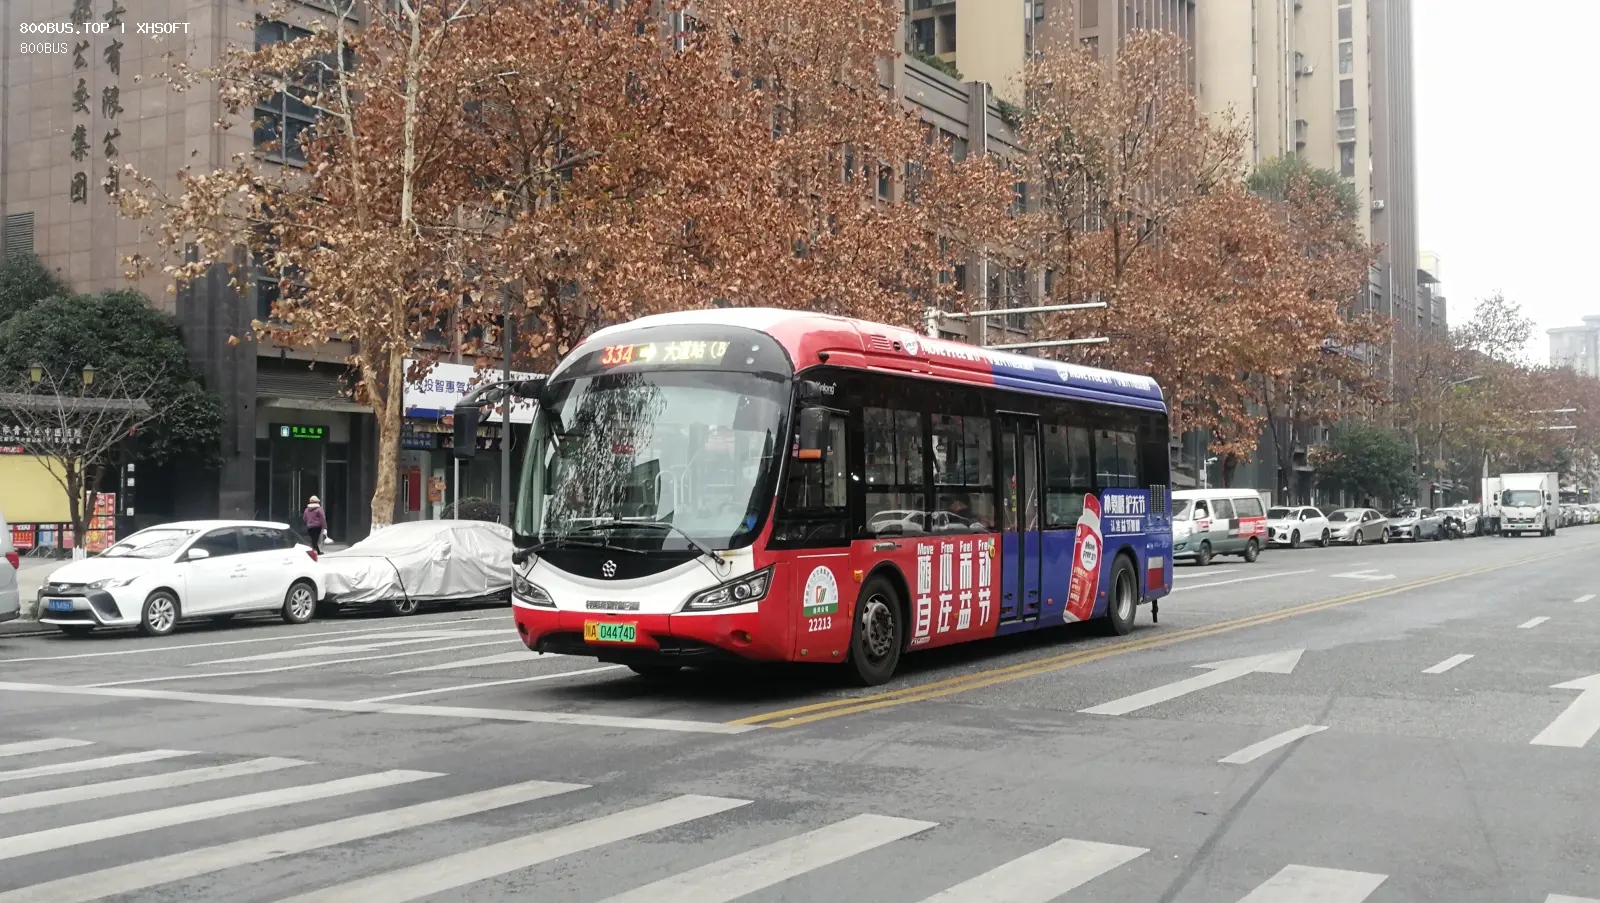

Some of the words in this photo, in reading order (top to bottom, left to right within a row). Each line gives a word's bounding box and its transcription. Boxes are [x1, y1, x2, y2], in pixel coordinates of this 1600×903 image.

[601, 343, 634, 365] 334
[917, 542, 934, 556] Move
[940, 541, 954, 553] Free
[914, 587, 991, 637] 自在益节
[600, 624, 636, 640] 04474D
[808, 616, 832, 633] 22213
